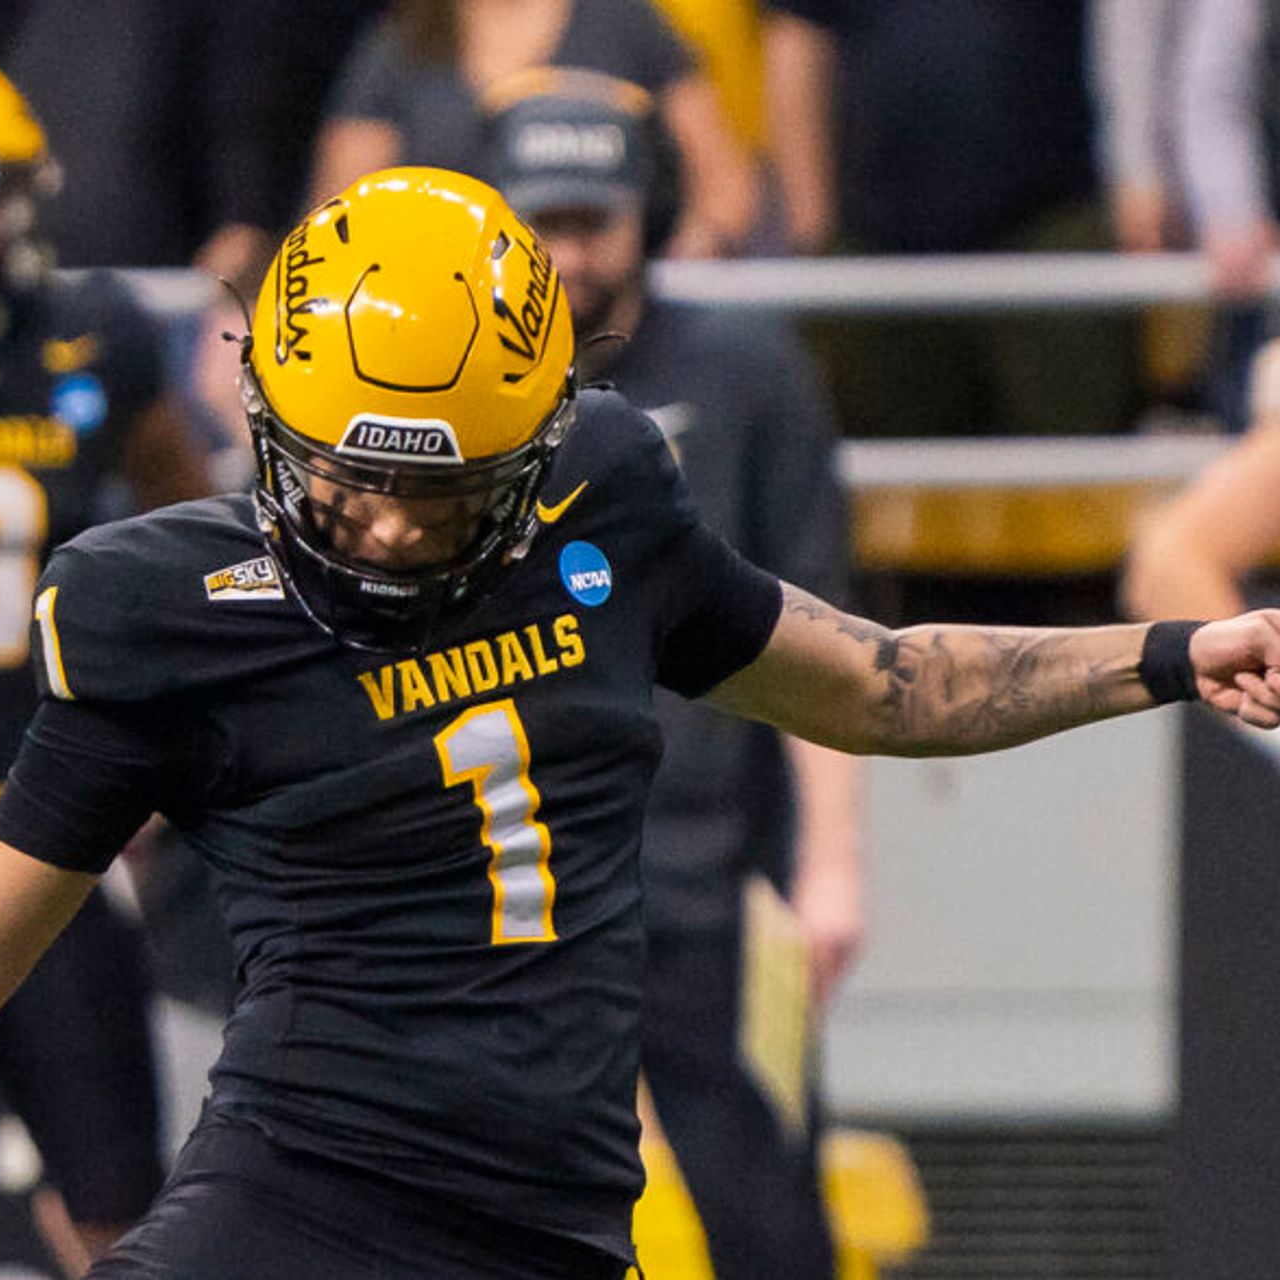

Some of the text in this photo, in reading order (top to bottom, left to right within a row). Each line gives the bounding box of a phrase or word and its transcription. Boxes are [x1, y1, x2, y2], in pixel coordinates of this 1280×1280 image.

[357, 424, 443, 453] IDAHO
[570, 568, 611, 592] NCAA
[35, 586, 75, 700] 1
[357, 613, 586, 720] VANDALS
[433, 697, 559, 945] 1
